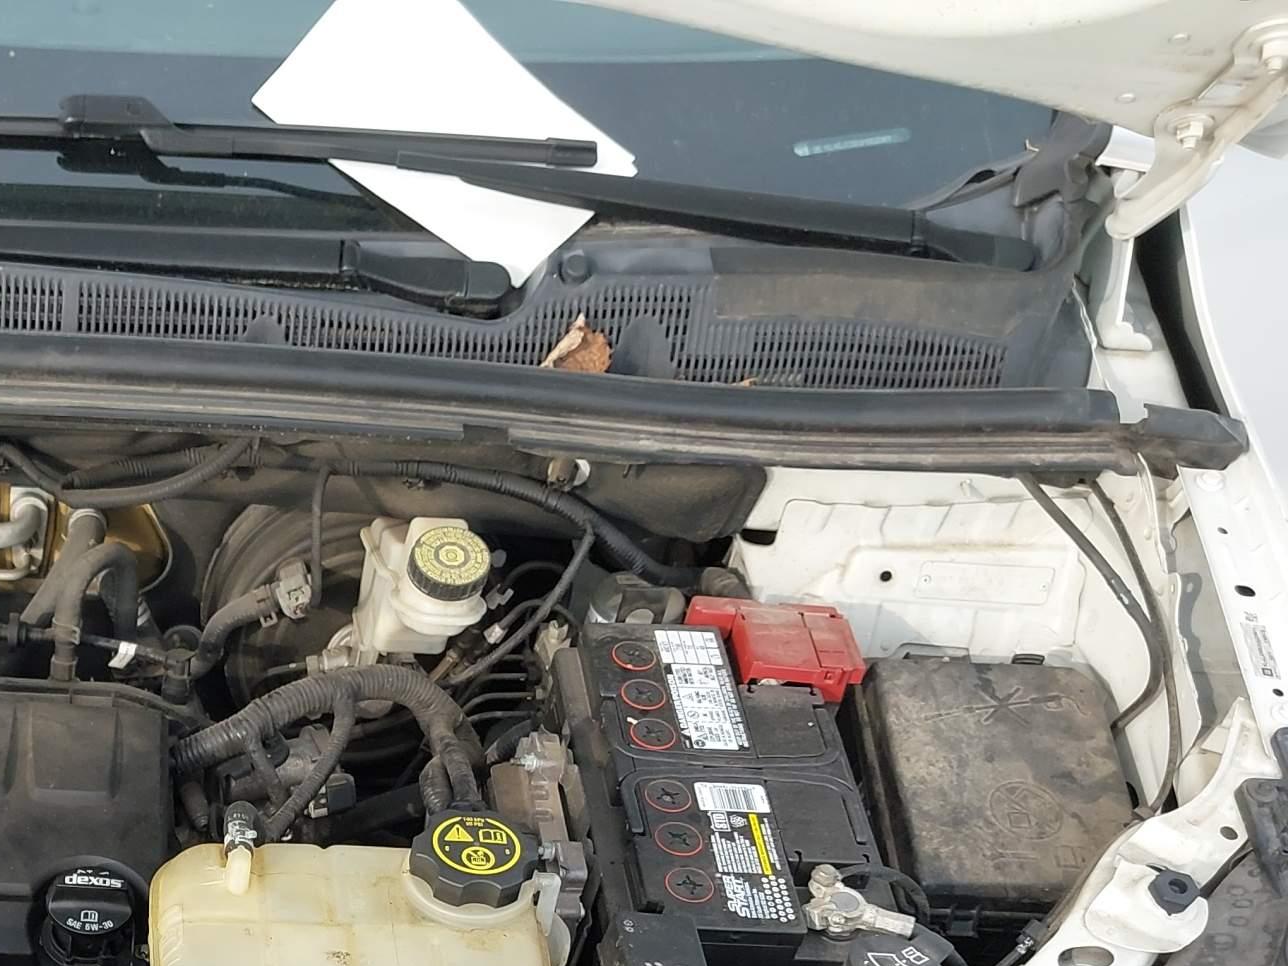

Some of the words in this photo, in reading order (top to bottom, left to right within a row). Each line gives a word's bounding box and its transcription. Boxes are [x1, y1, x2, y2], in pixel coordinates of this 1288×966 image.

[65, 873, 124, 888] dexos
[722, 874, 738, 911] SUPER
[732, 876, 751, 917] START
[66, 918, 82, 930] SAE
